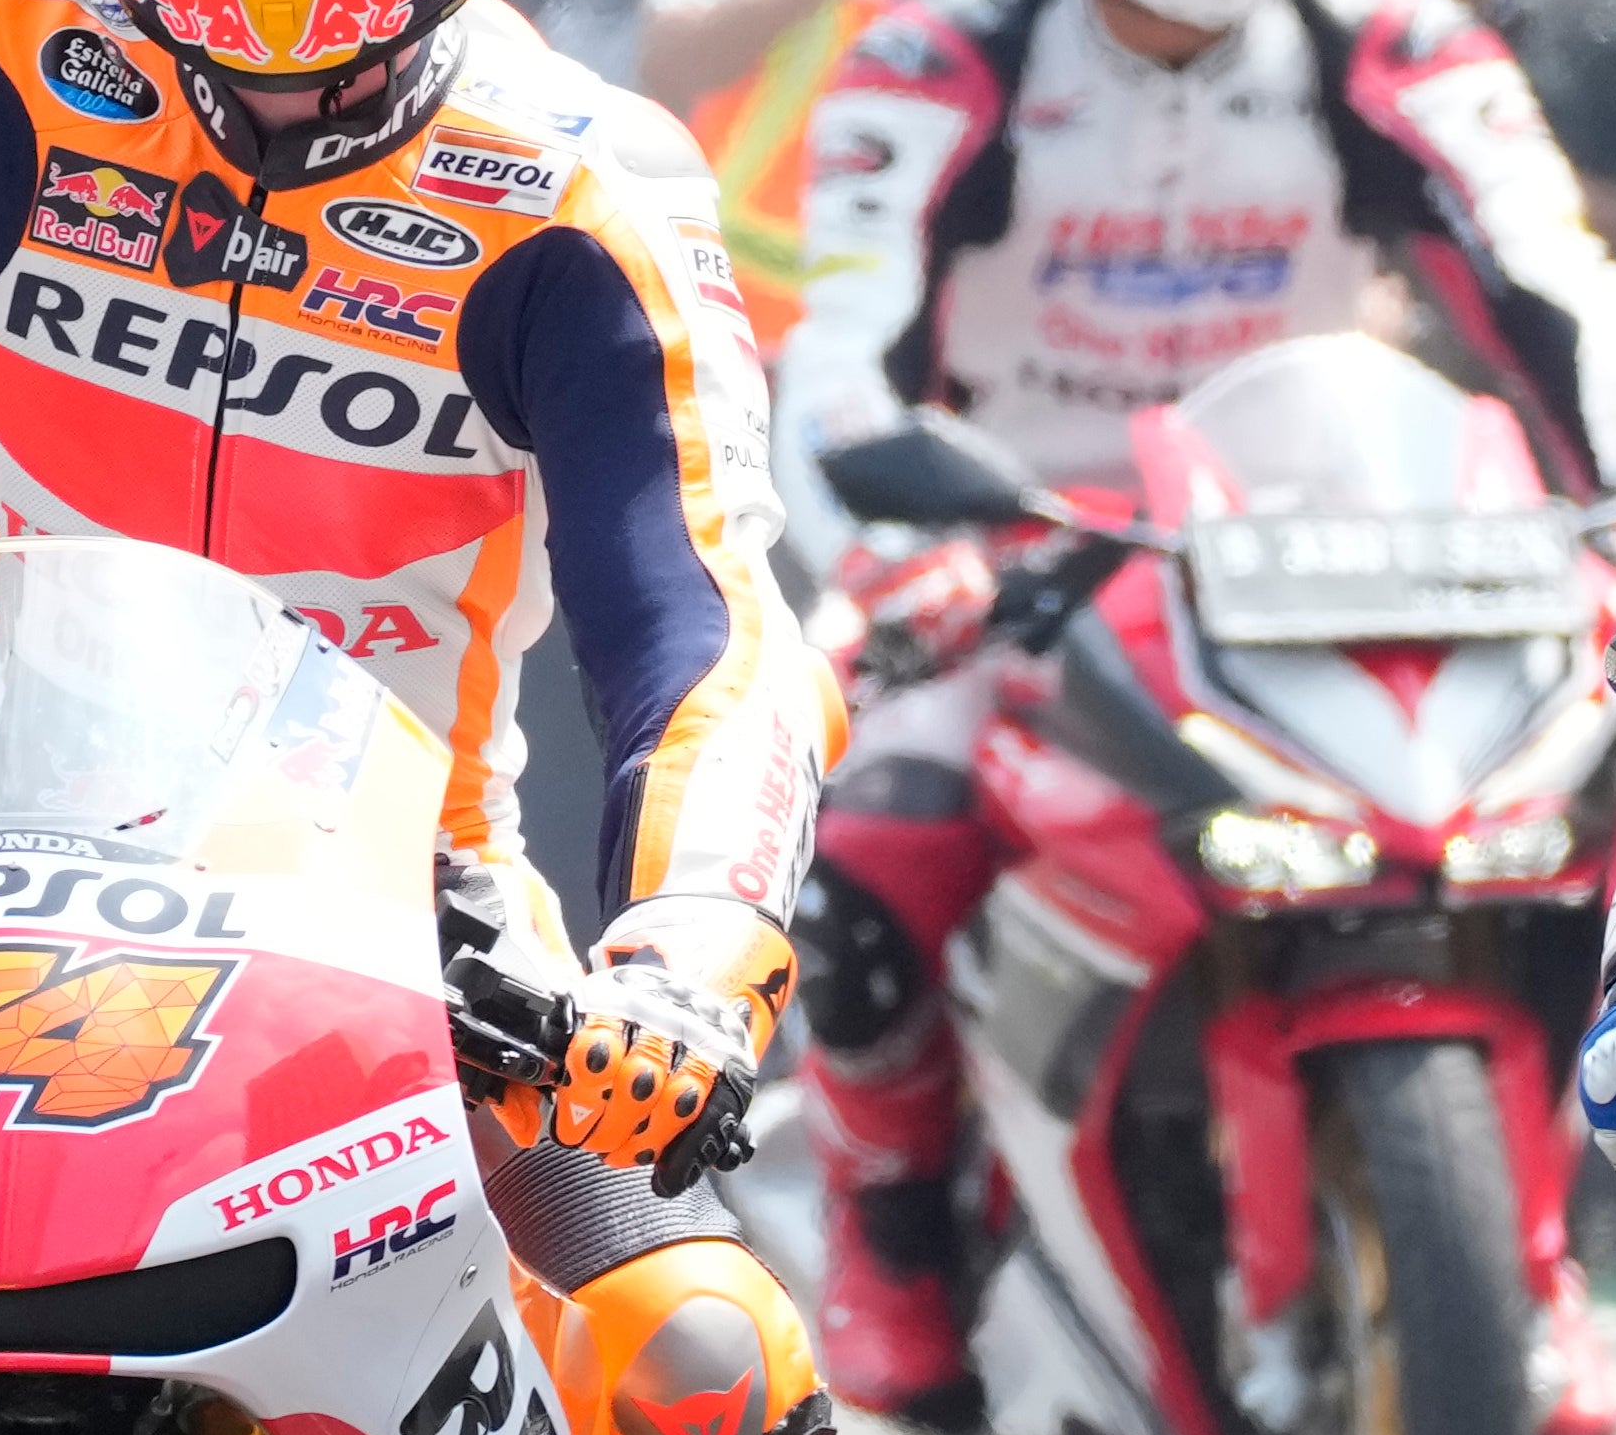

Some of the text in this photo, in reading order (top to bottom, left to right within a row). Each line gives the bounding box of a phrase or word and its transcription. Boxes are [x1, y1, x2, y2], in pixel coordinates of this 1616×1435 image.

[60, 58, 135, 107] Galicia
[64, 36, 143, 94] Estrella
[429, 151, 555, 191] REPSOL
[36, 204, 155, 267] Red Bull
[348, 206, 458, 256] HJC
[298, 309, 439, 355] Honda RACING
[302, 268, 462, 346] HRC
[5, 270, 477, 458] REPSOL
[215, 1116, 452, 1232] HONDA
[330, 1227, 455, 1293] Honda RACING
[332, 1180, 457, 1280] HRC
